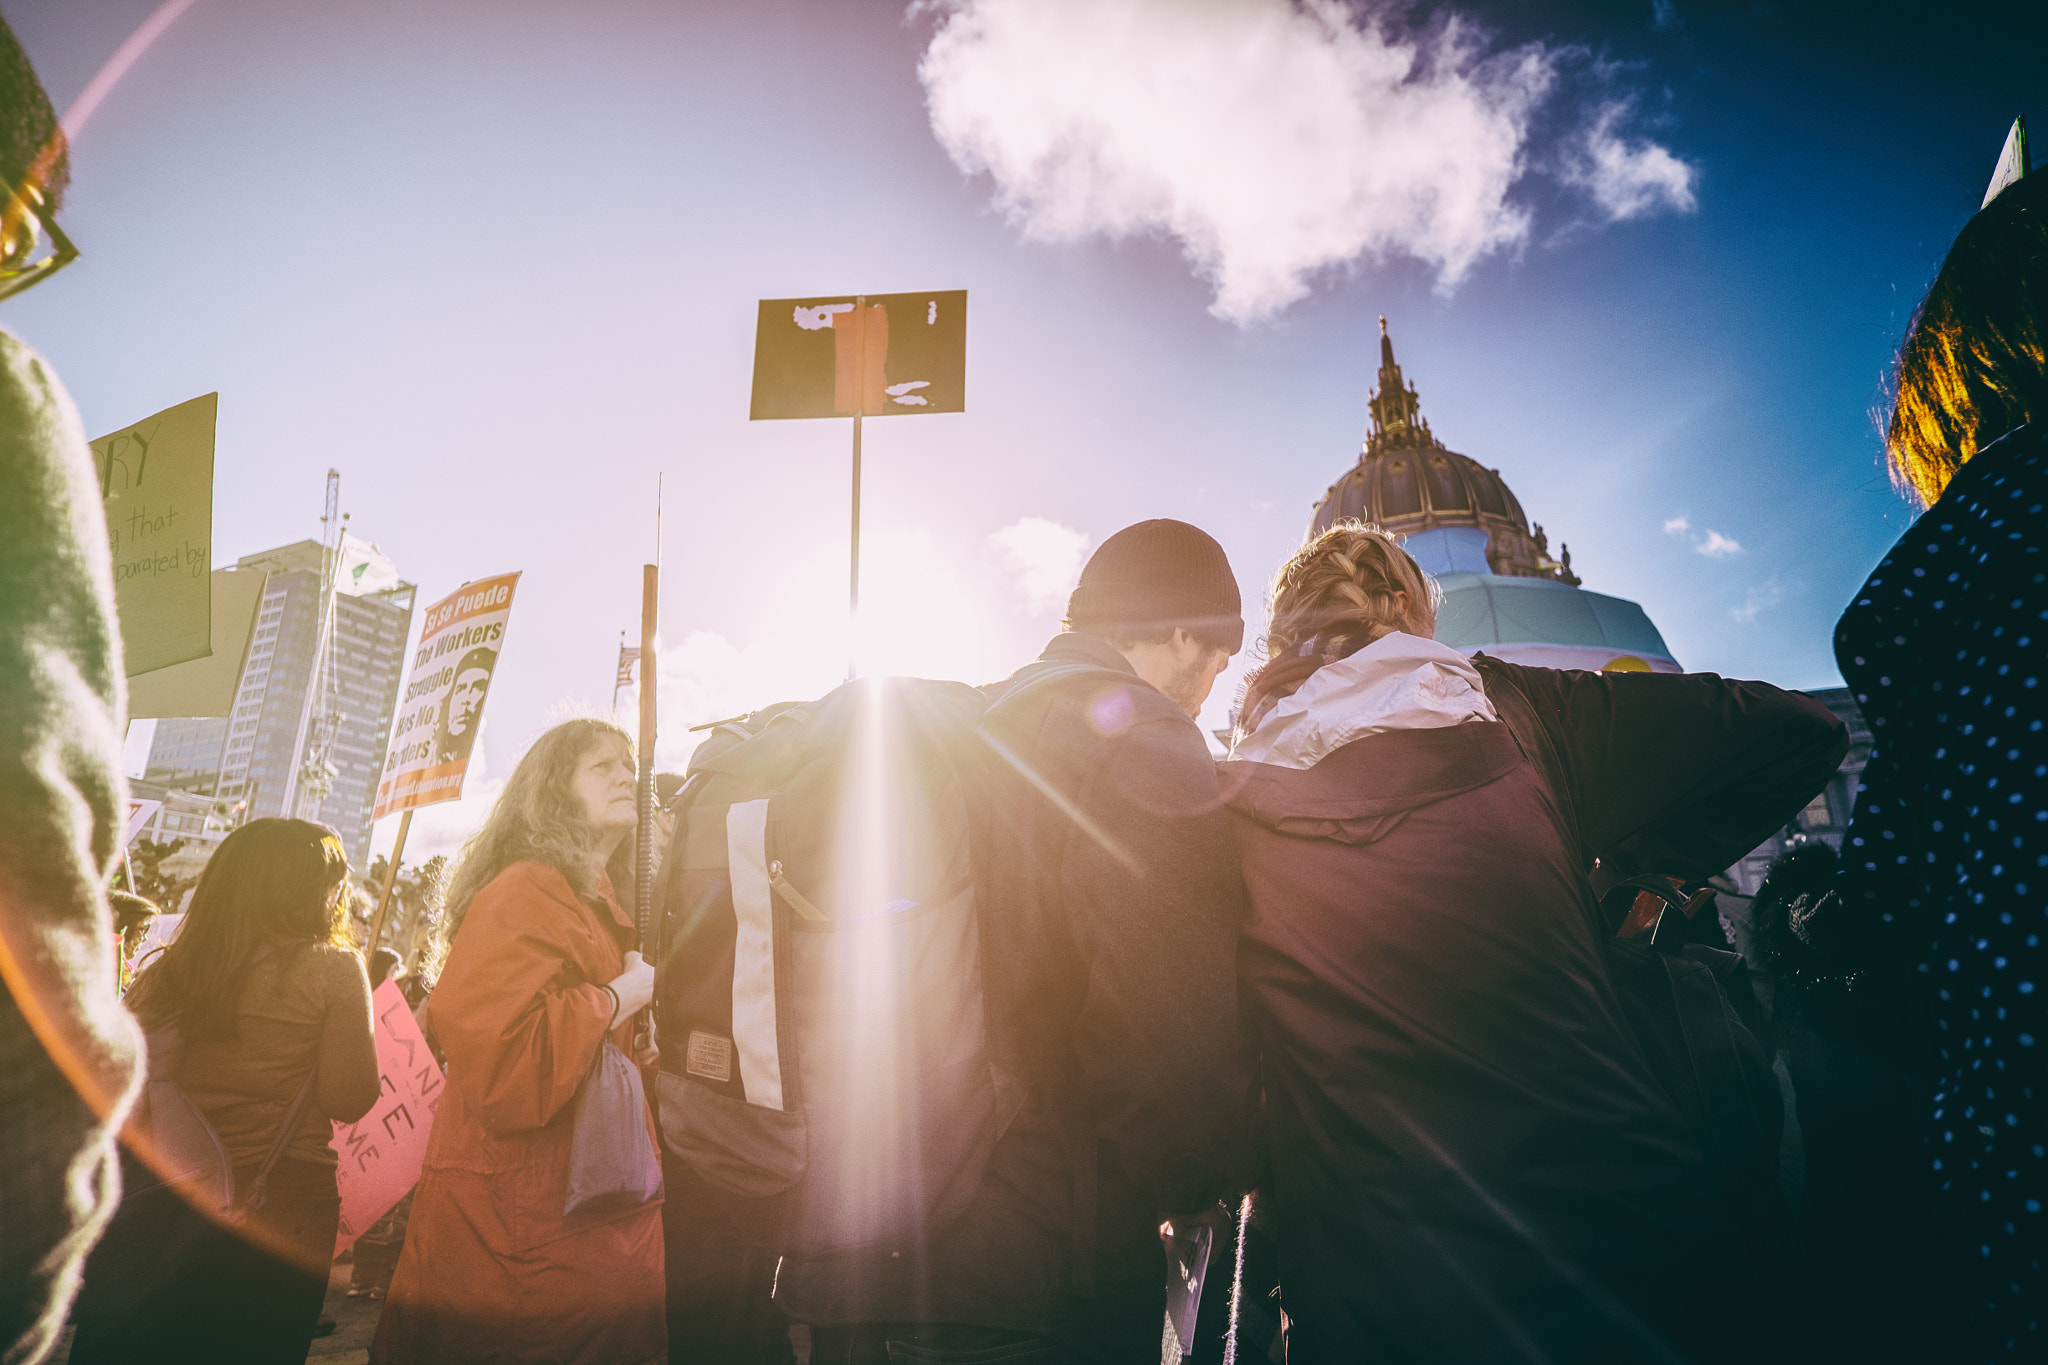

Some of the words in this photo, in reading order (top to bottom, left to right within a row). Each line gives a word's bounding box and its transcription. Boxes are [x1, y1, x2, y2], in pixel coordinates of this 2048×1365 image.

[127, 504, 178, 542] that
[186, 540, 206, 578] by
[437, 605, 453, 625] Se
[454, 584, 509, 617] Puede
[414, 645, 434, 671] The
[434, 622, 502, 658] Workers
[405, 666, 453, 704] Struggle
[395, 713, 415, 739] Has
[415, 705, 434, 729] No
[386, 740, 430, 773] Borders
